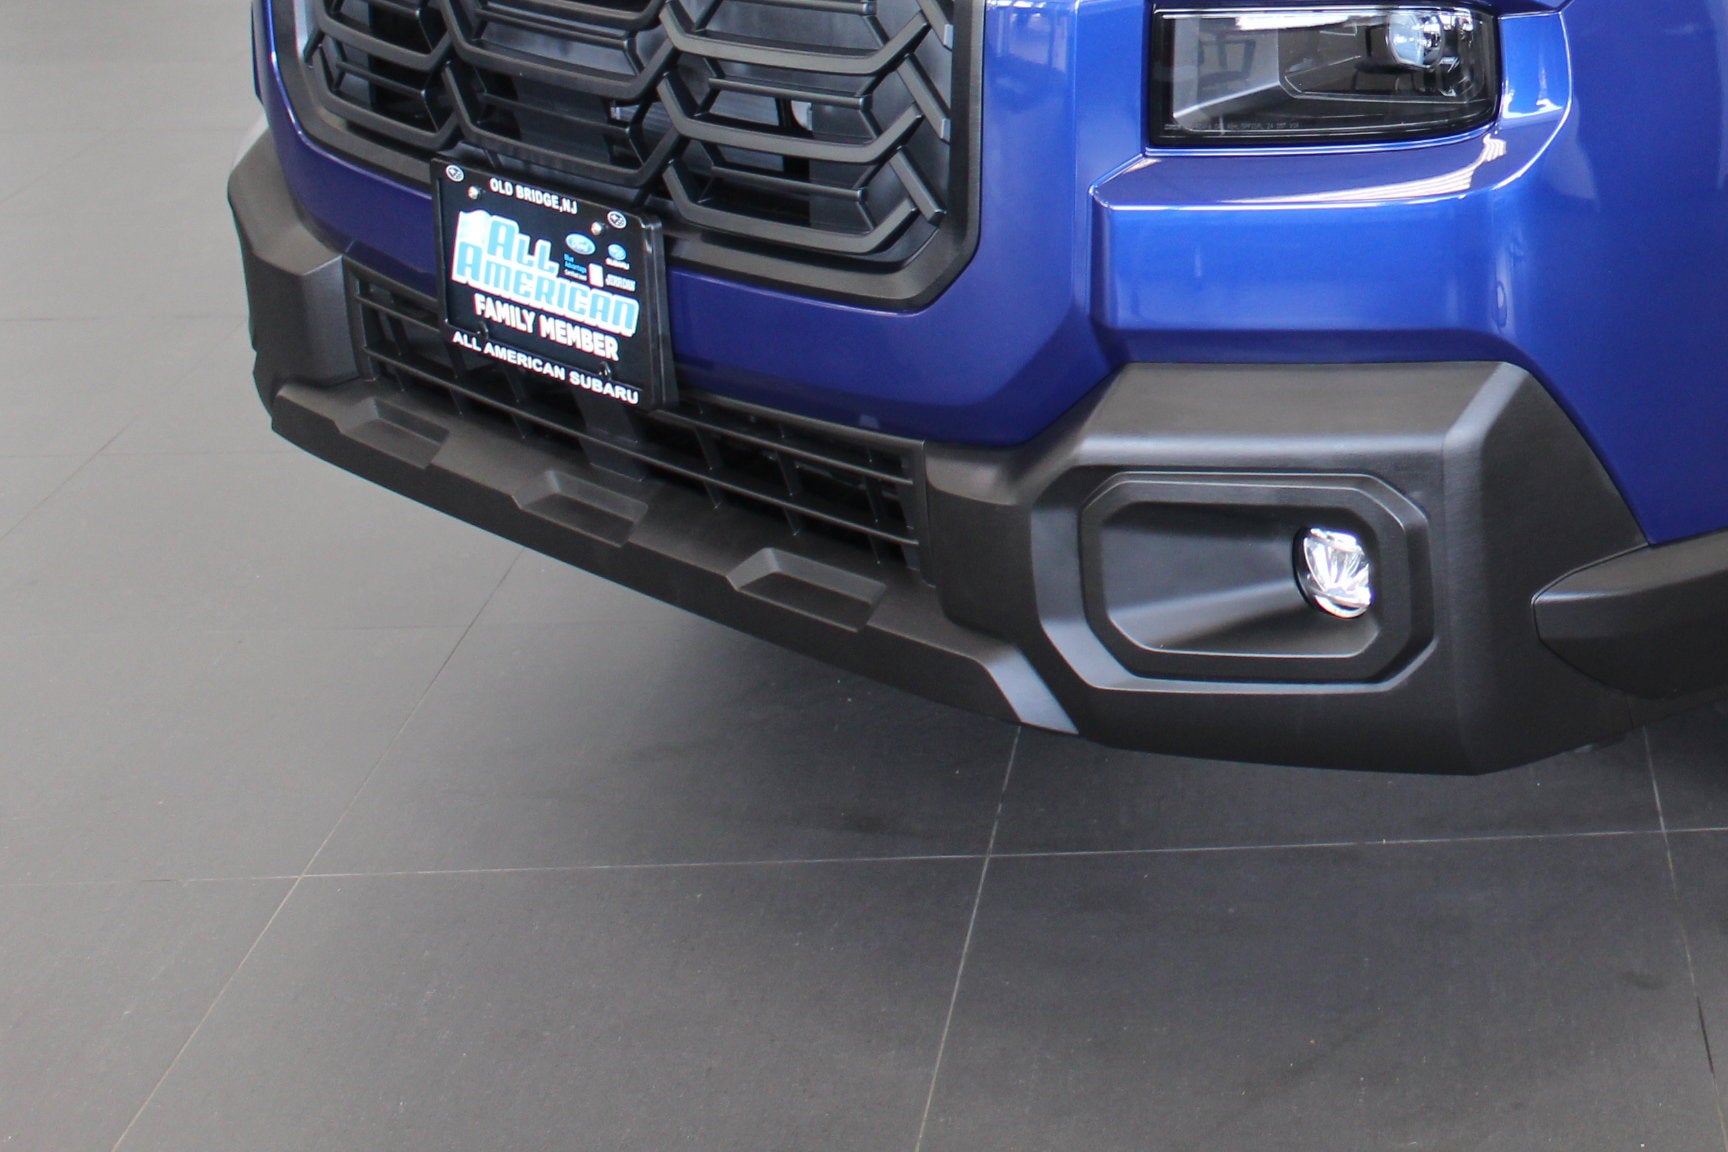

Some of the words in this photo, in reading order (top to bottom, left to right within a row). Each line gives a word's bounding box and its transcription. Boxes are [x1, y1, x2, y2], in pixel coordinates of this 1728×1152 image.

[489, 177, 514, 196] OLD
[487, 216, 560, 278] ALL
[452, 240, 640, 337] AMERICAN
[475, 293, 536, 334] FAMILY
[539, 314, 620, 361] MEMBER
[453, 330, 483, 352] ALL
[484, 342, 566, 381] AMERICAN
[569, 370, 640, 404] SUBARU
